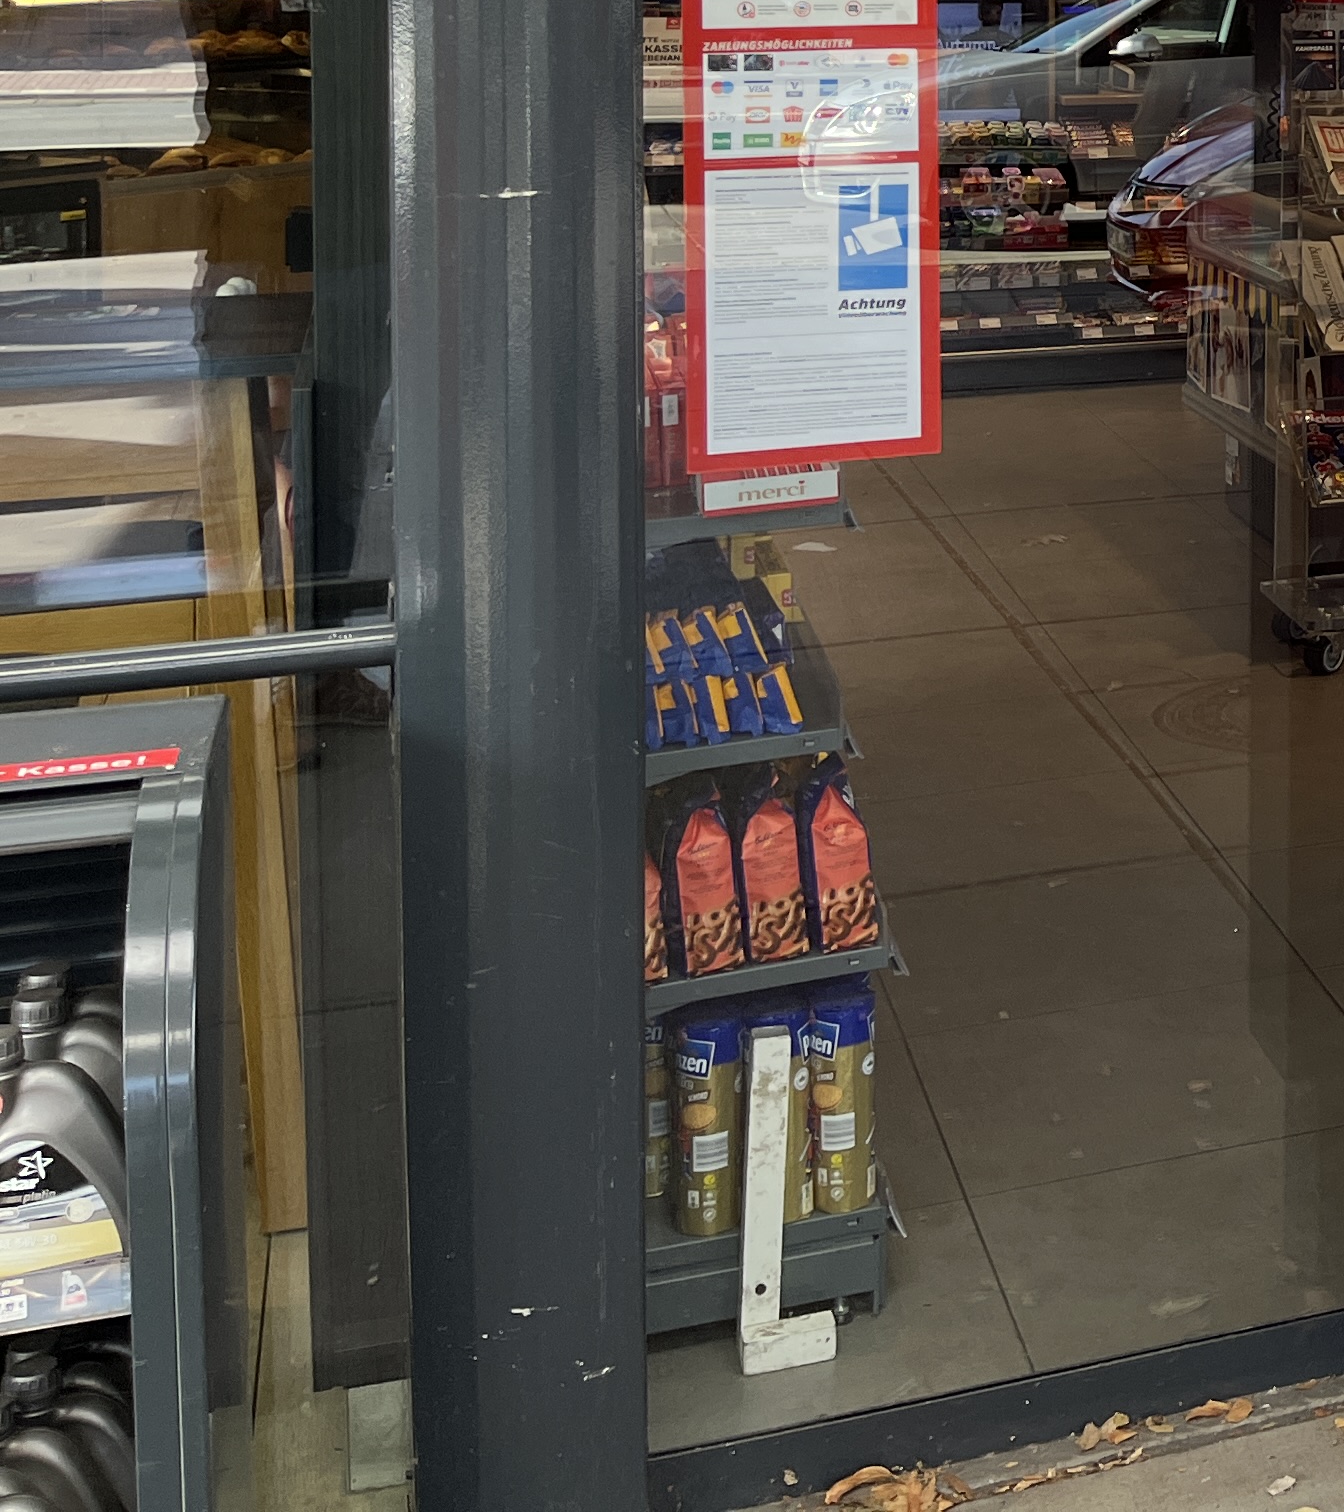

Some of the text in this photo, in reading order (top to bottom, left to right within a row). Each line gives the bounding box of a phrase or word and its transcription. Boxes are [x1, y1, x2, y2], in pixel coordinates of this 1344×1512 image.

[702, 39, 853, 51] ZAHLUNGSMÖGLICHKEITEN
[838, 298, 907, 311] Achtung
[738, 479, 808, 502] merci
